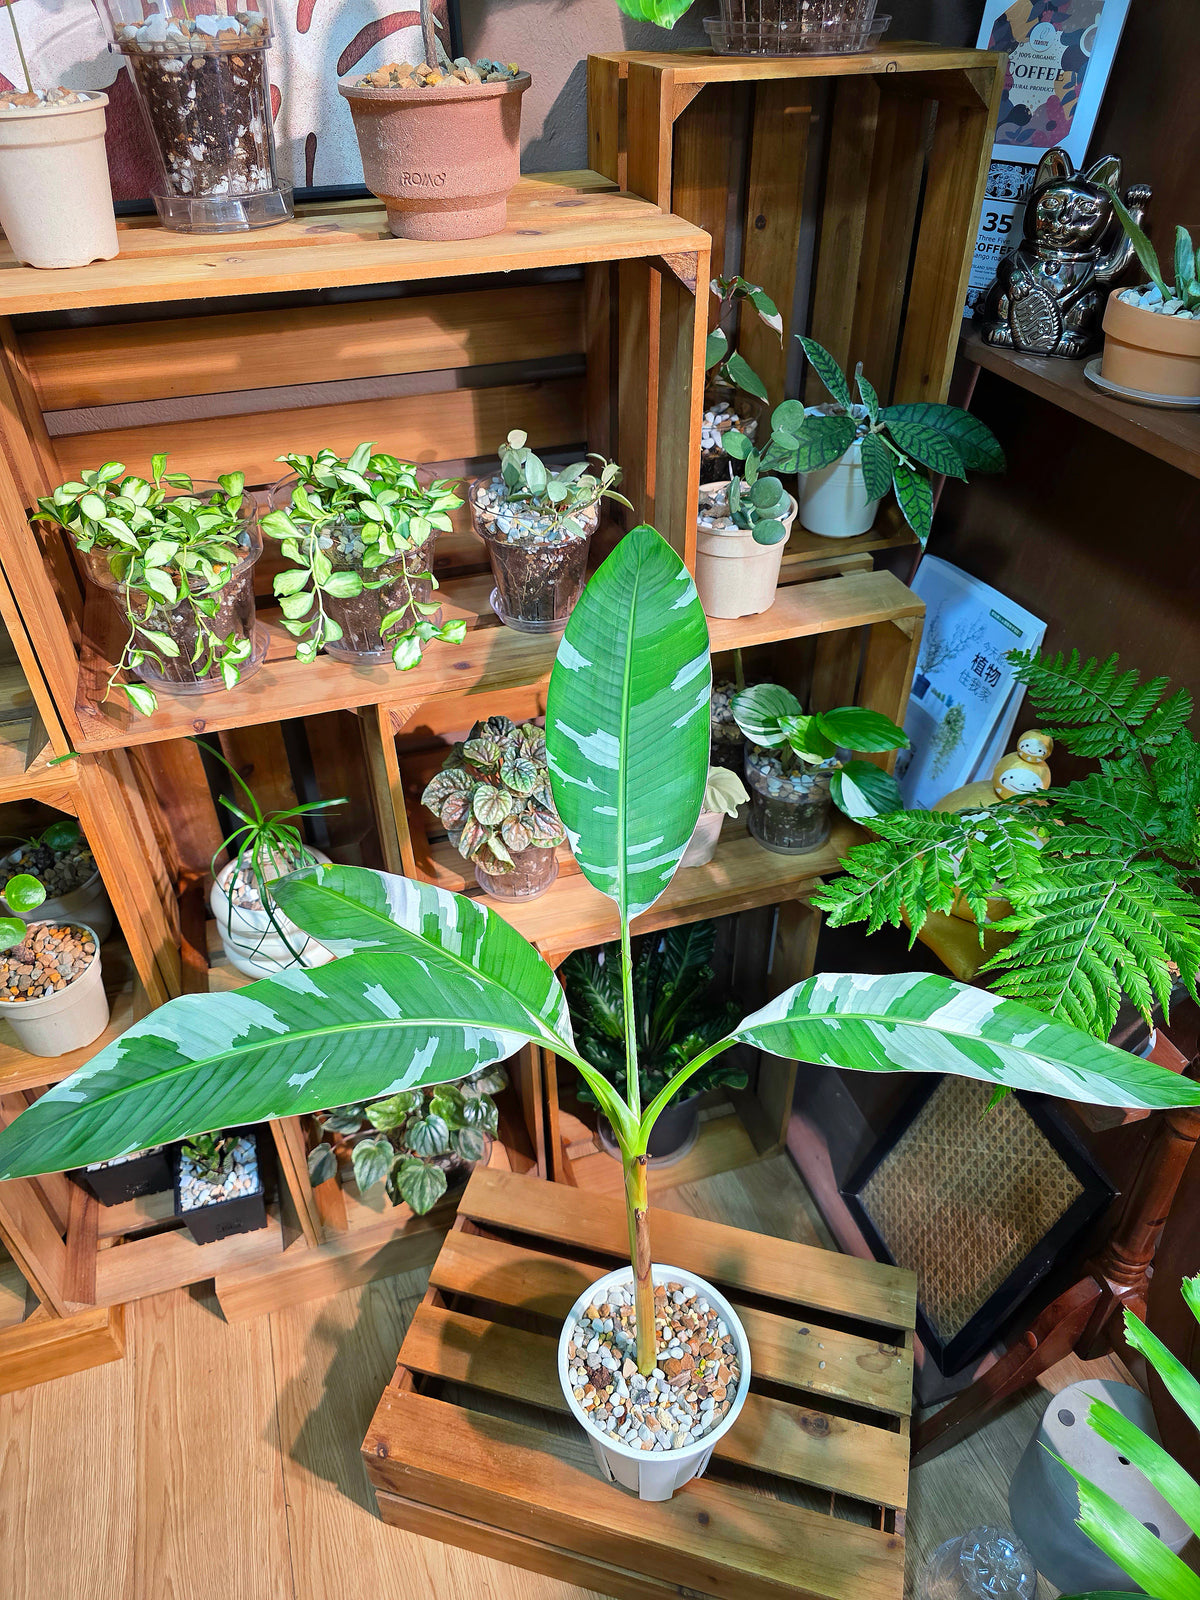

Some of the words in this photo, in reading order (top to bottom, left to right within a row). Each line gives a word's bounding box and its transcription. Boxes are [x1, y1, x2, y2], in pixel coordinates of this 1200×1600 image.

[1006, 61, 1065, 82] COFFEE
[982, 212, 1014, 234] 35
[971, 652, 1001, 687] 植物
[959, 669, 991, 704] 住我家
